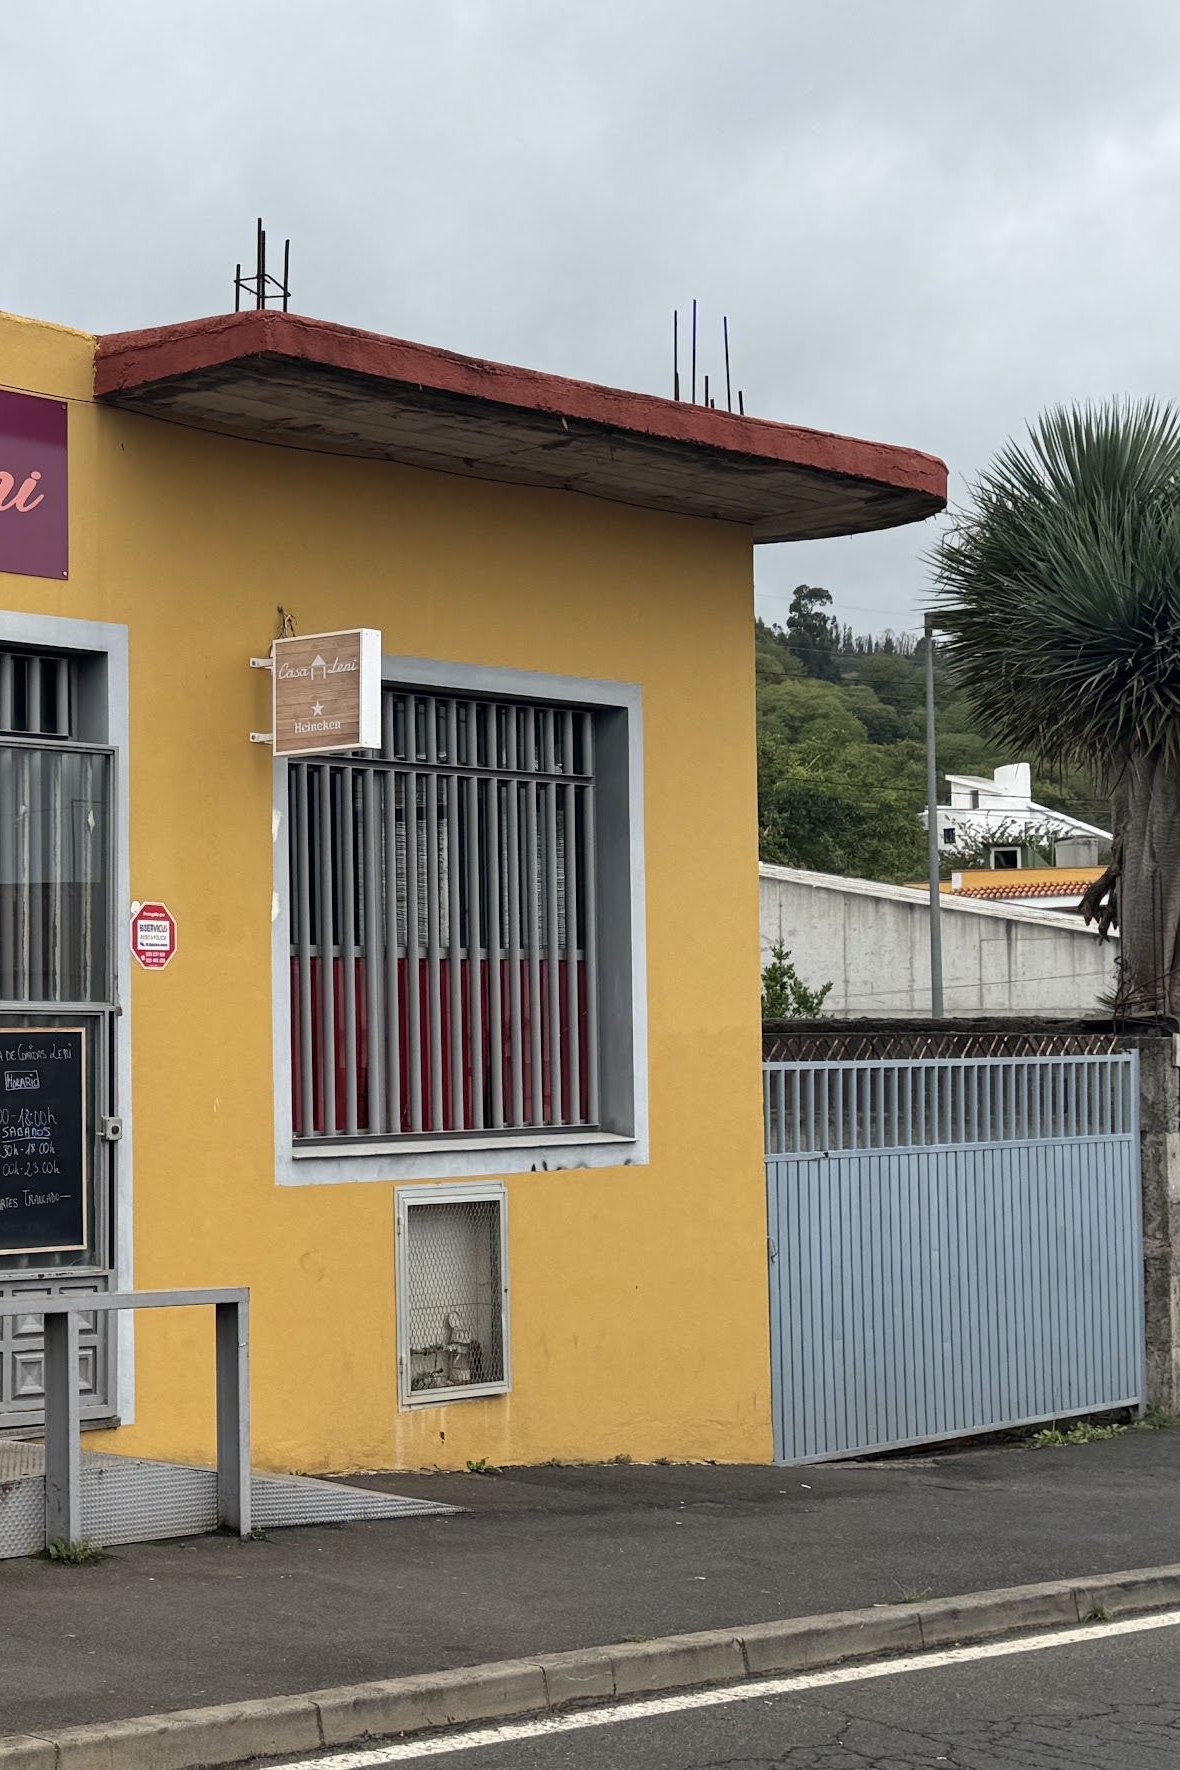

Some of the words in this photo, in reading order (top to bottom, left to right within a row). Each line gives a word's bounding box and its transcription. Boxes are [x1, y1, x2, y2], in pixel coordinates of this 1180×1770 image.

[278, 662, 309, 680] Casa
[327, 656, 358, 674] Leni
[294, 720, 341, 734] Heineken
